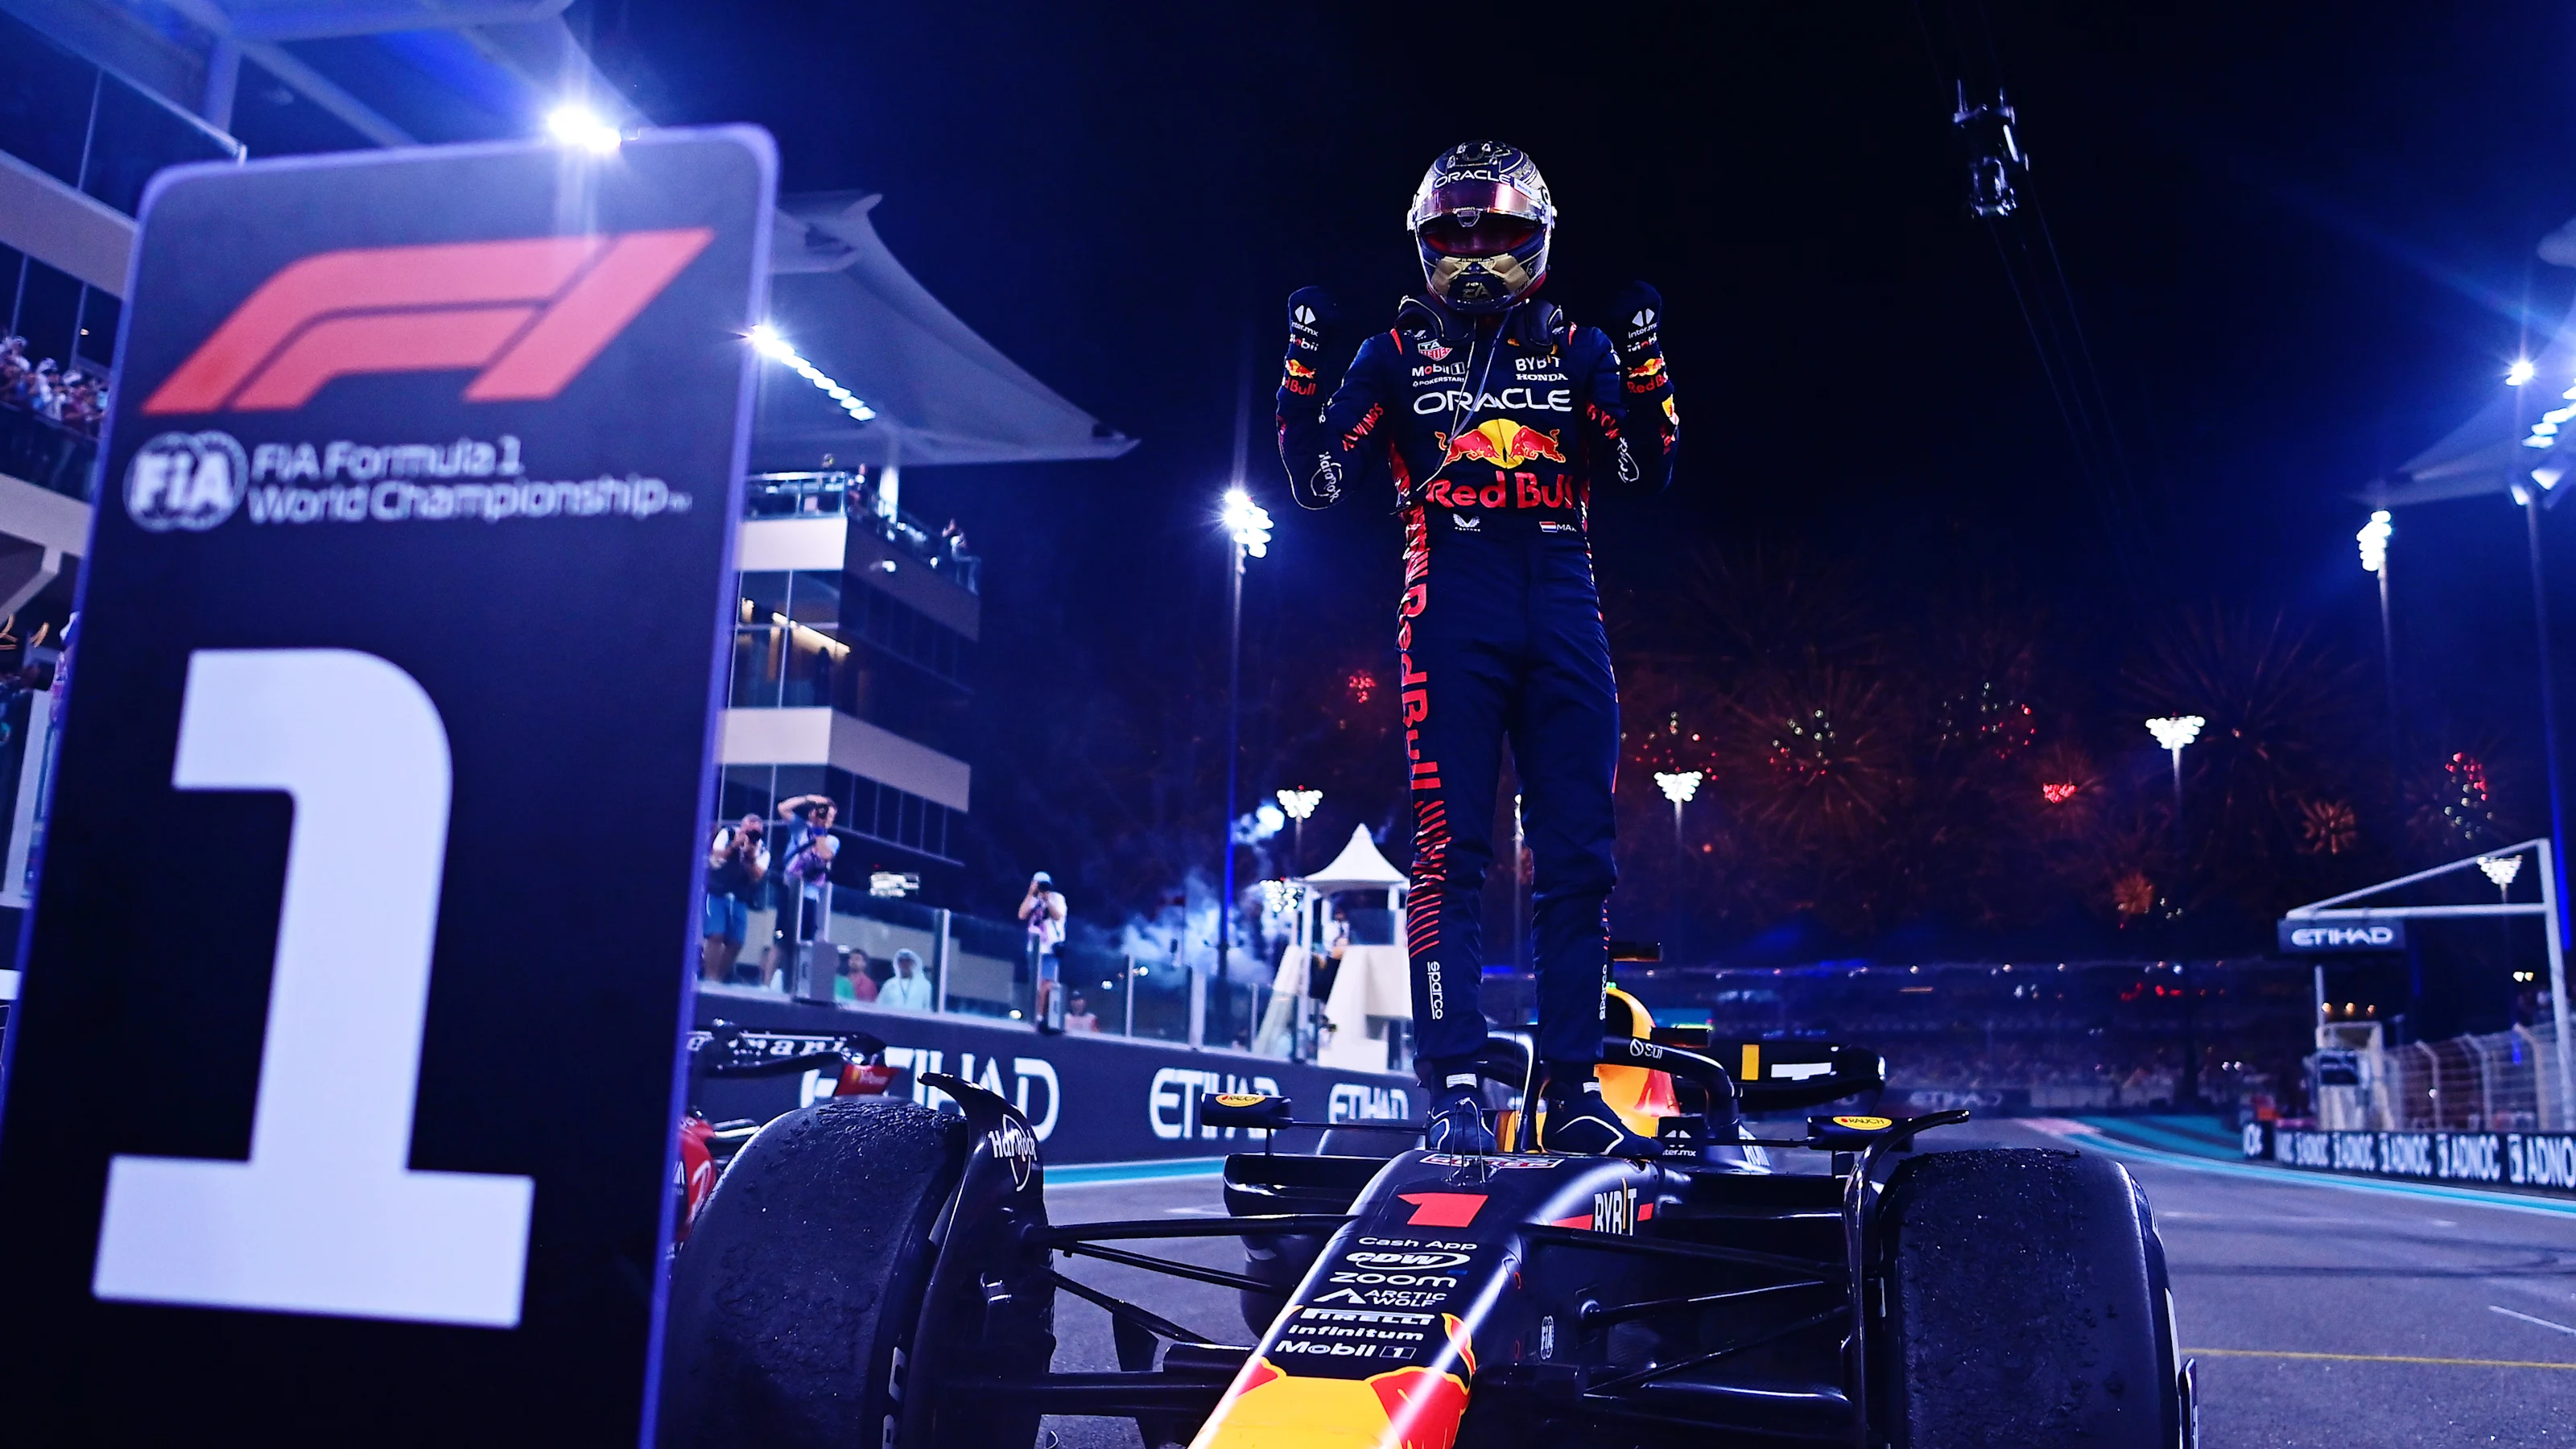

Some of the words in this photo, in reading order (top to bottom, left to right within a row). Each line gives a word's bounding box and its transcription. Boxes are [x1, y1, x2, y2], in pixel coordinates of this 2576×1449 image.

[1434, 169, 1511, 188] ORACLE
[1411, 363, 1450, 377] Mobil
[1515, 355, 1562, 371] BYBIT
[1515, 373, 1569, 382] HONDA
[1413, 388, 1573, 415] ORACLE
[250, 442, 321, 482] FIA
[324, 439, 497, 481] Formula
[496, 433, 524, 476] 1
[1425, 471, 1506, 509] Red
[1515, 472, 1574, 509] Bull
[246, 483, 369, 524] World
[1402, 689, 1442, 790] Bull
[2290, 927, 2393, 947] ETIHAD
[91, 647, 535, 1330] 1
[1427, 961, 1443, 1020] sparco
[1599, 964, 1608, 1021] sparco
[1645, 1043, 1663, 1059] Sui
[1662, 1149, 1696, 1158] ter.mx
[2450, 1133, 2501, 1182] ADNOC
[2526, 1135, 2576, 1190] ADNO
[1397, 1192, 1488, 1228] 1
[1358, 1236, 1419, 1248] Cash
[1425, 1240, 1478, 1251] App
[1346, 1252, 1444, 1265] CDW
[1364, 1289, 1447, 1301] ARCTIC
[1373, 1296, 1436, 1307] WOLF
[1299, 1307, 1435, 1325] PIRELLI
[1287, 1324, 1424, 1340] infinitum
[1274, 1340, 1377, 1357] Mobil
